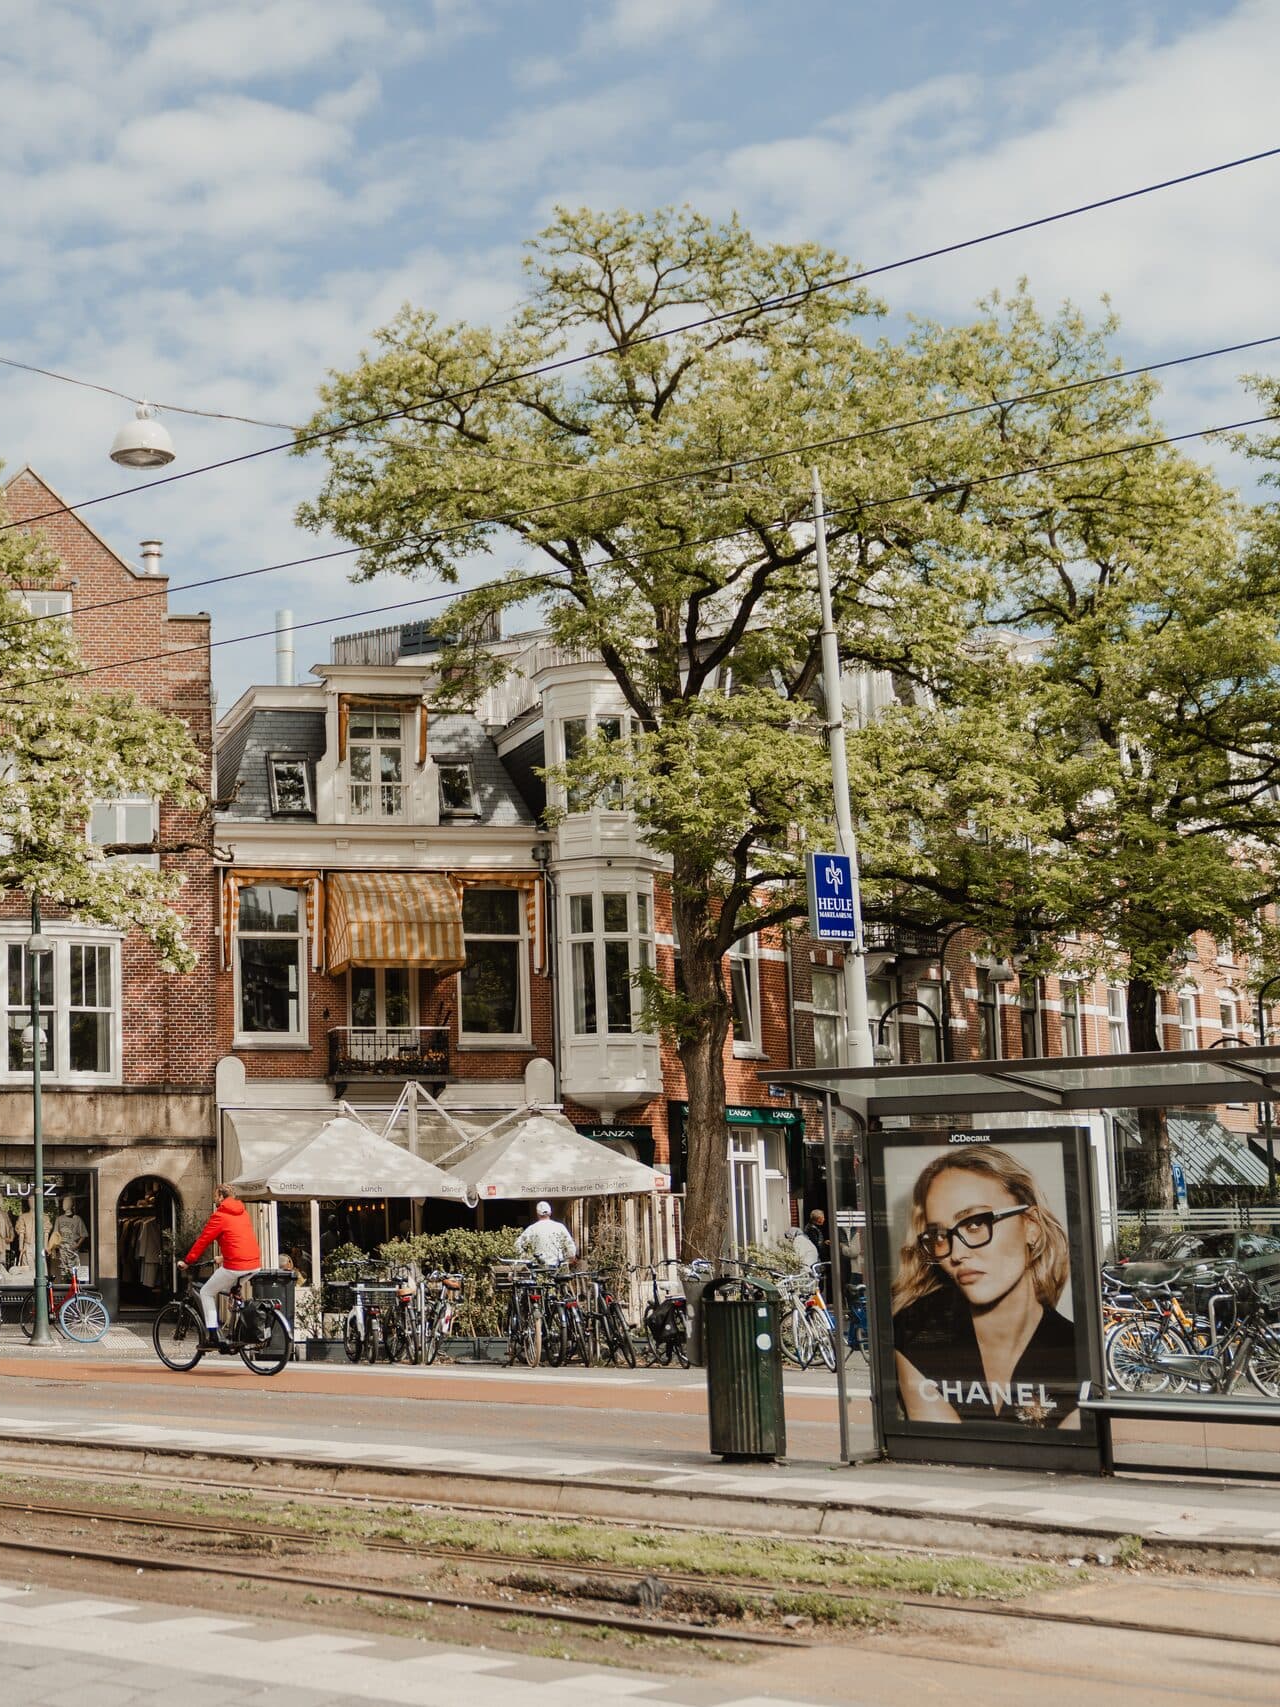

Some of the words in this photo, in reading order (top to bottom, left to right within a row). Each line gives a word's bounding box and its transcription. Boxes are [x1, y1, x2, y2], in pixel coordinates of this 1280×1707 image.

[818, 897, 853, 912] HEULE
[949, 1134, 991, 1143] JCDecaux
[6, 1183, 57, 1196] LUZ
[280, 1183, 305, 1192] Ontbijt
[361, 1185, 383, 1193] Lunch
[521, 1185, 559, 1193] Restaurant
[561, 1184, 593, 1192] Brasserie
[919, 1379, 1058, 1408] CHANEL
